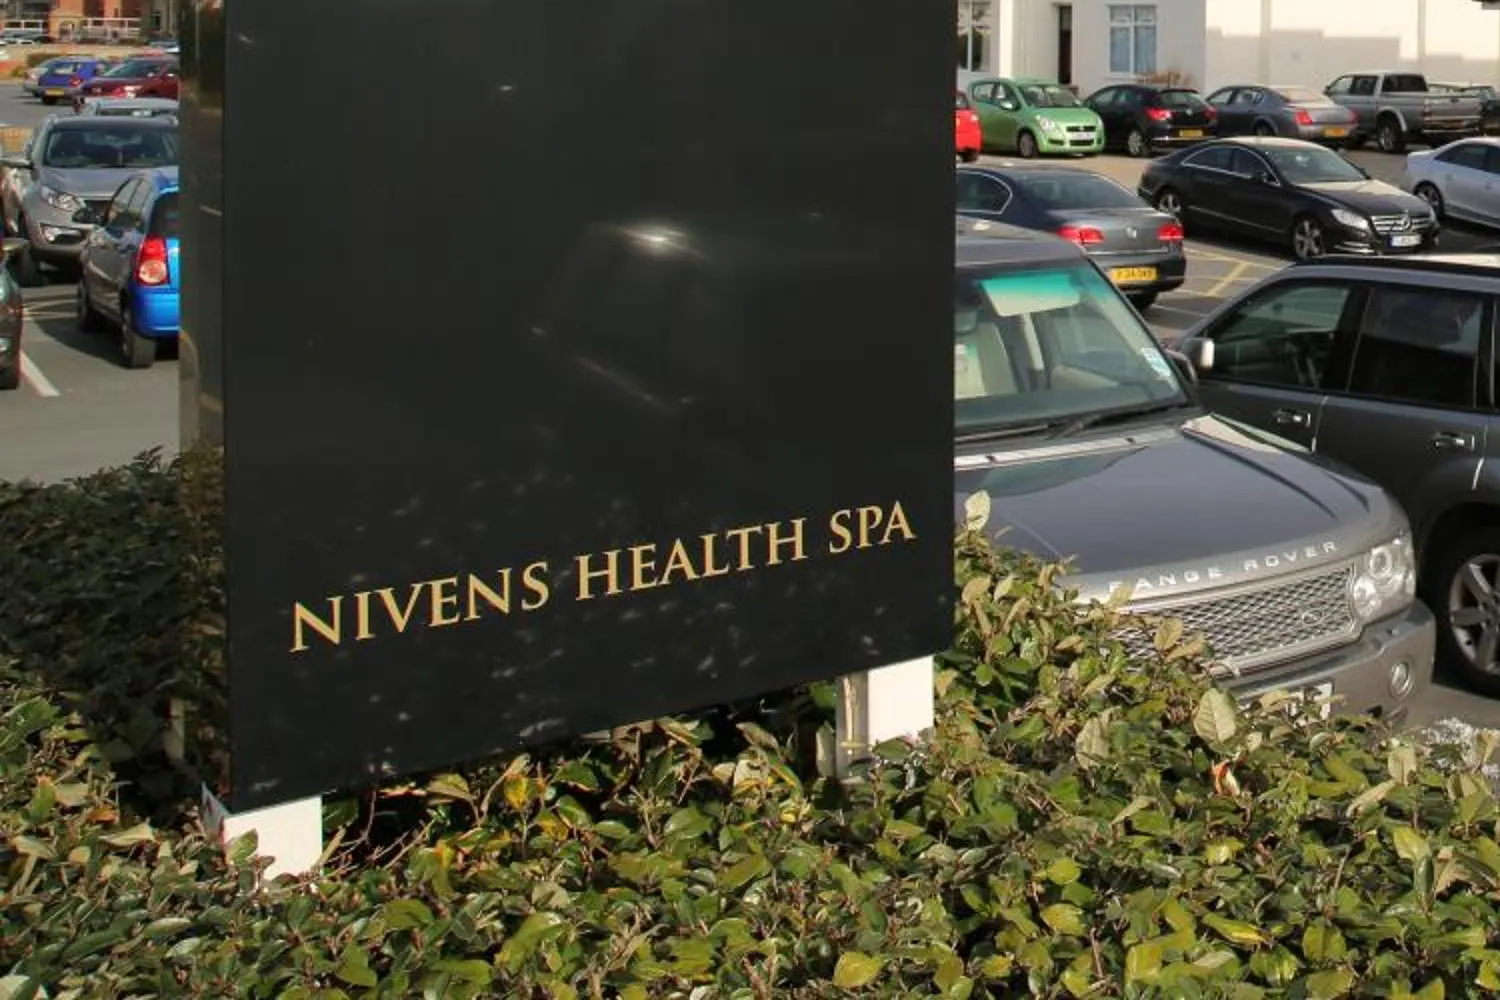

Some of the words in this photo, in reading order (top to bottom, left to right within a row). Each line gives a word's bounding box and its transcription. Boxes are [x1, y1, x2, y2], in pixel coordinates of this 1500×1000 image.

[288, 560, 550, 653] NIVENS
[574, 517, 808, 600] HEALTH
[828, 500, 917, 554] SPA
[1243, 540, 1338, 573] ROVER
